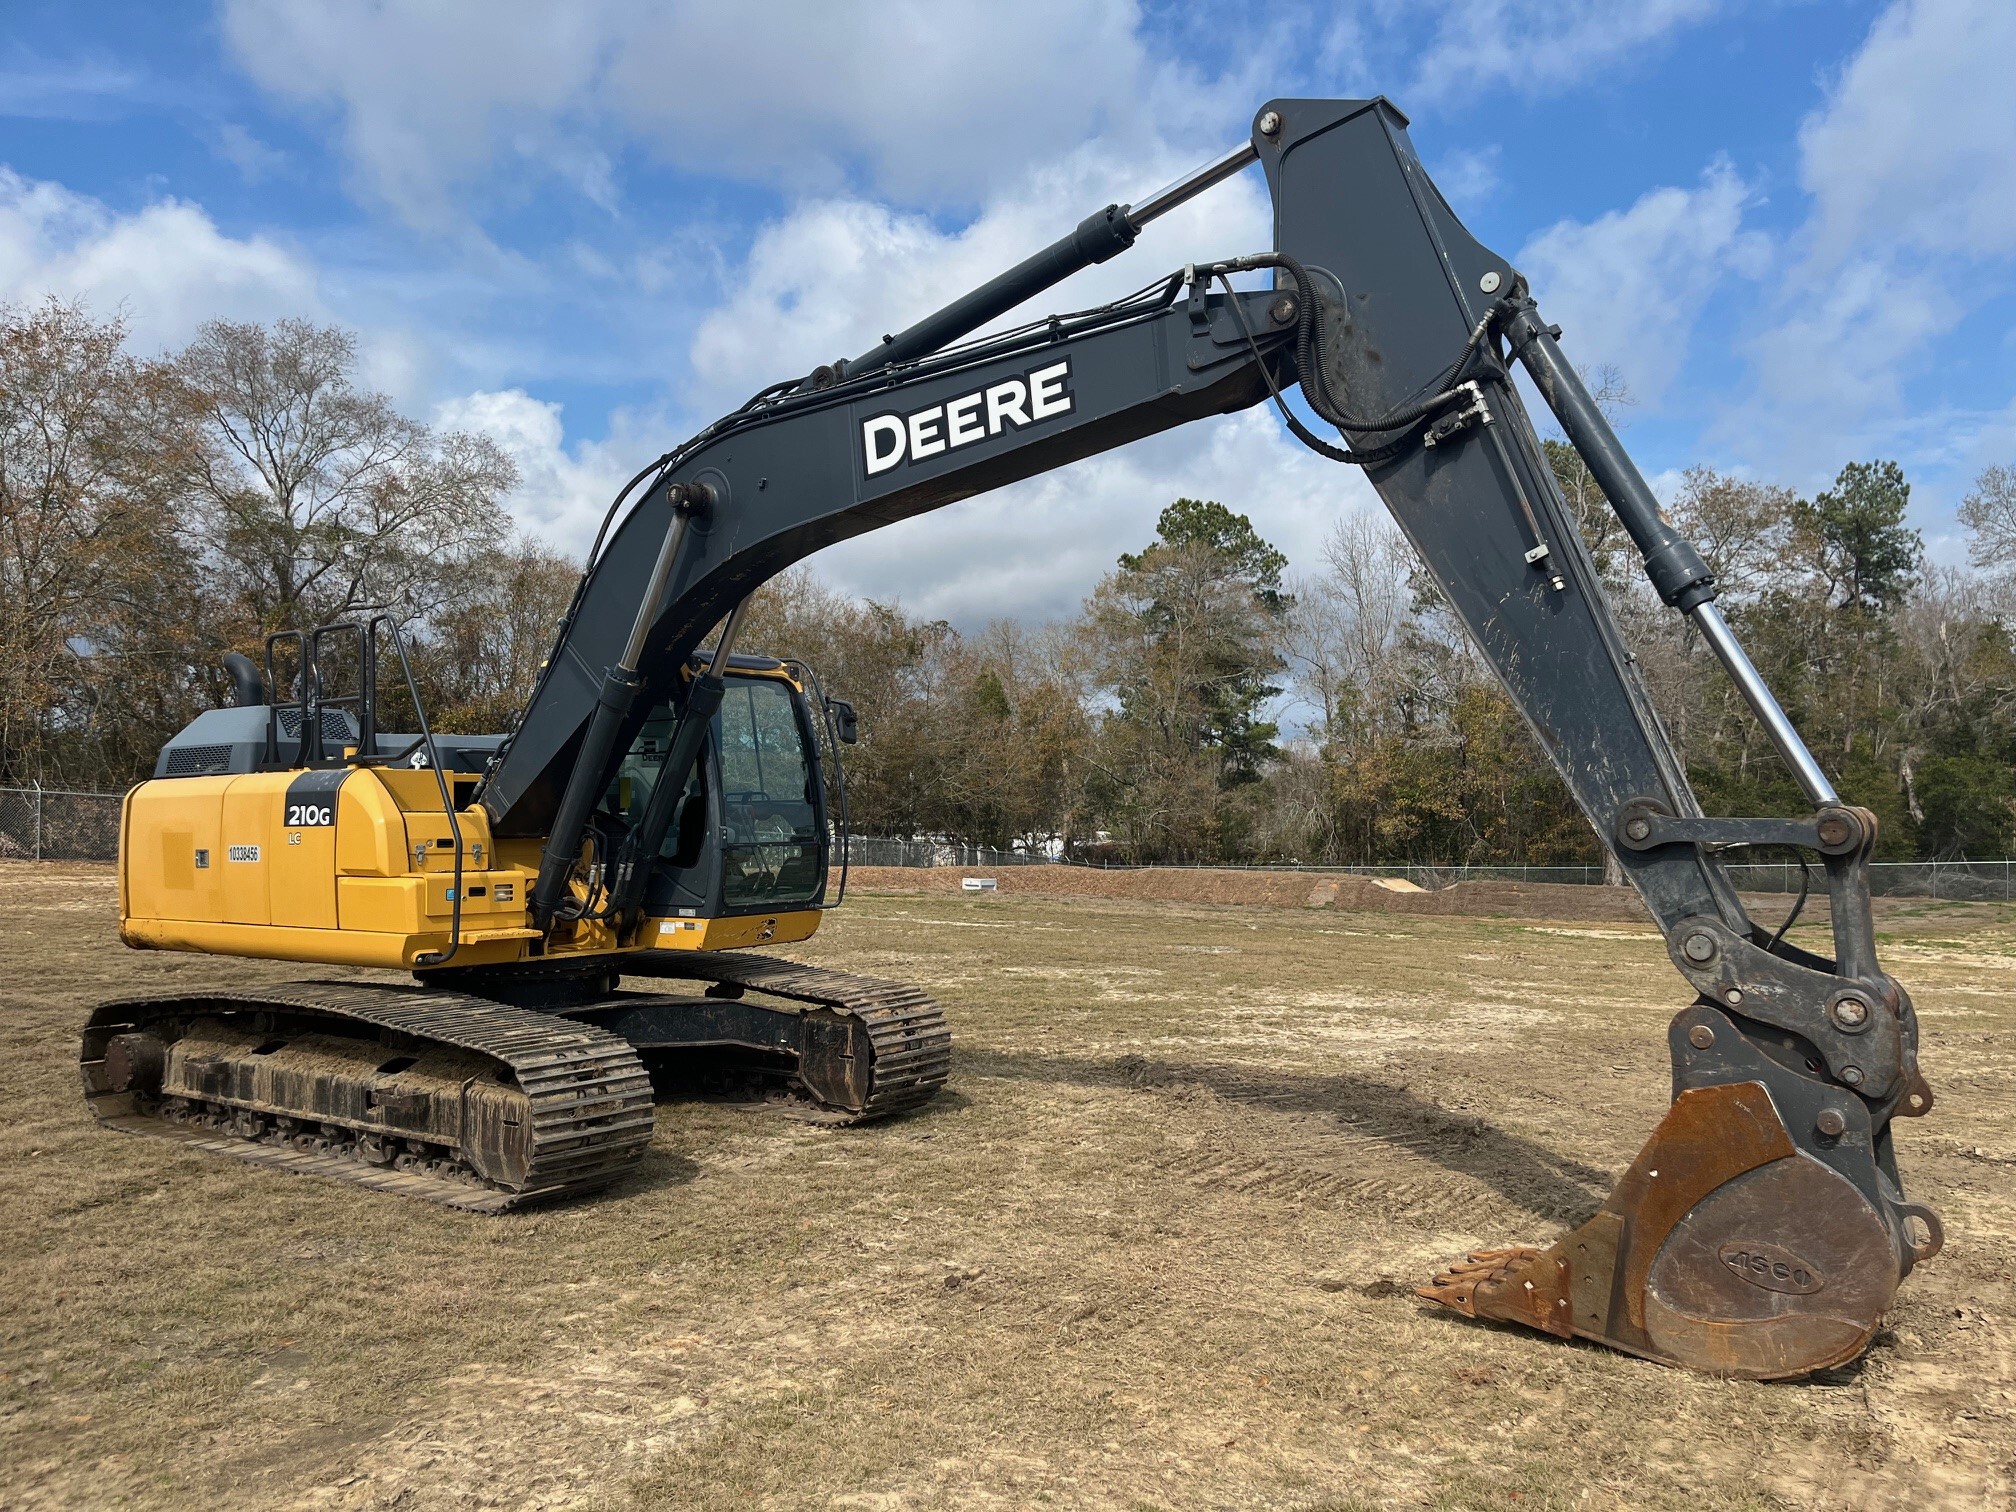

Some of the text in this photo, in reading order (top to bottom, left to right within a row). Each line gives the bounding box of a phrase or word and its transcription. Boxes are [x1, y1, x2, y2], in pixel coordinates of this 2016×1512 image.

[863, 361, 1070, 475] DEERE
[642, 753, 664, 761] DEER
[288, 805, 330, 825] 210G
[288, 832, 301, 844] LC
[229, 846, 258, 861] 10338456
